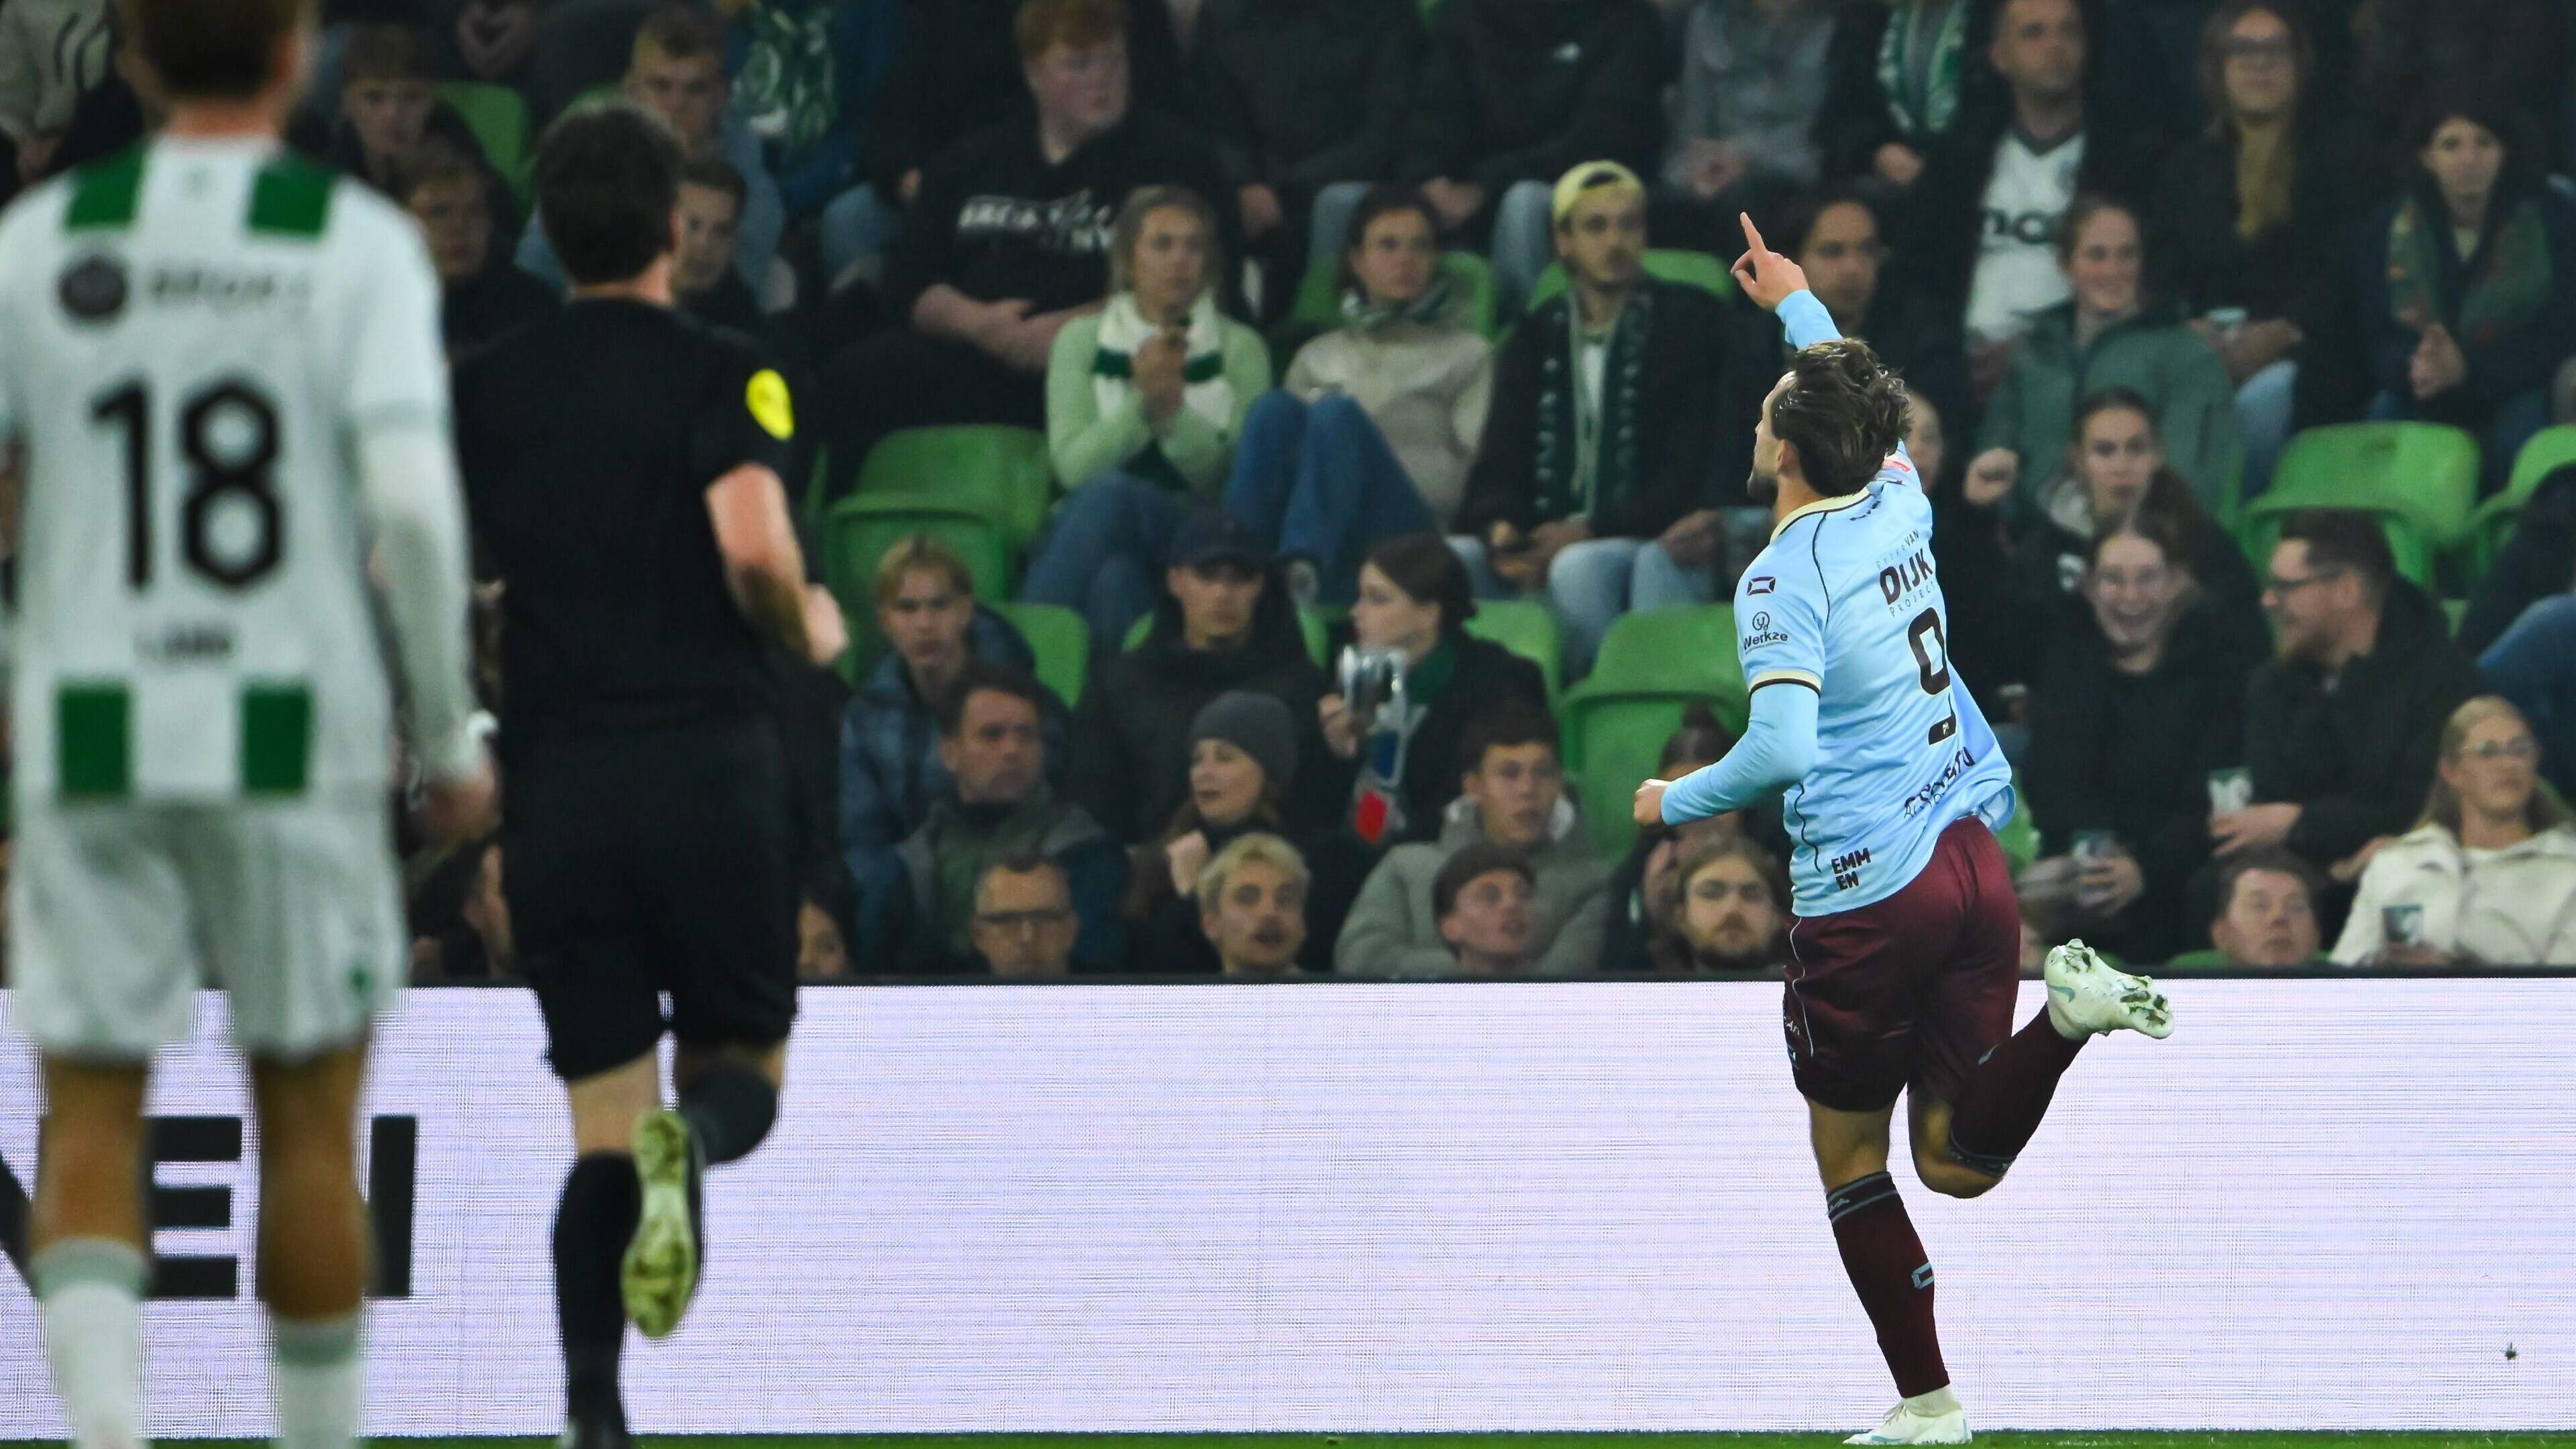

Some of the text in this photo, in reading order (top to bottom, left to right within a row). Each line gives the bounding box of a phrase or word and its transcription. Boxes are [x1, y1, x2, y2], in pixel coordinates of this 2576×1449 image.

[91, 372, 282, 594] 18
[1904, 529, 1919, 547] VAN
[1880, 547, 1933, 605] DIJK
[1908, 607, 1957, 745] 9
[1831, 847, 1872, 875] EMM
[1835, 871, 1859, 891] EN
